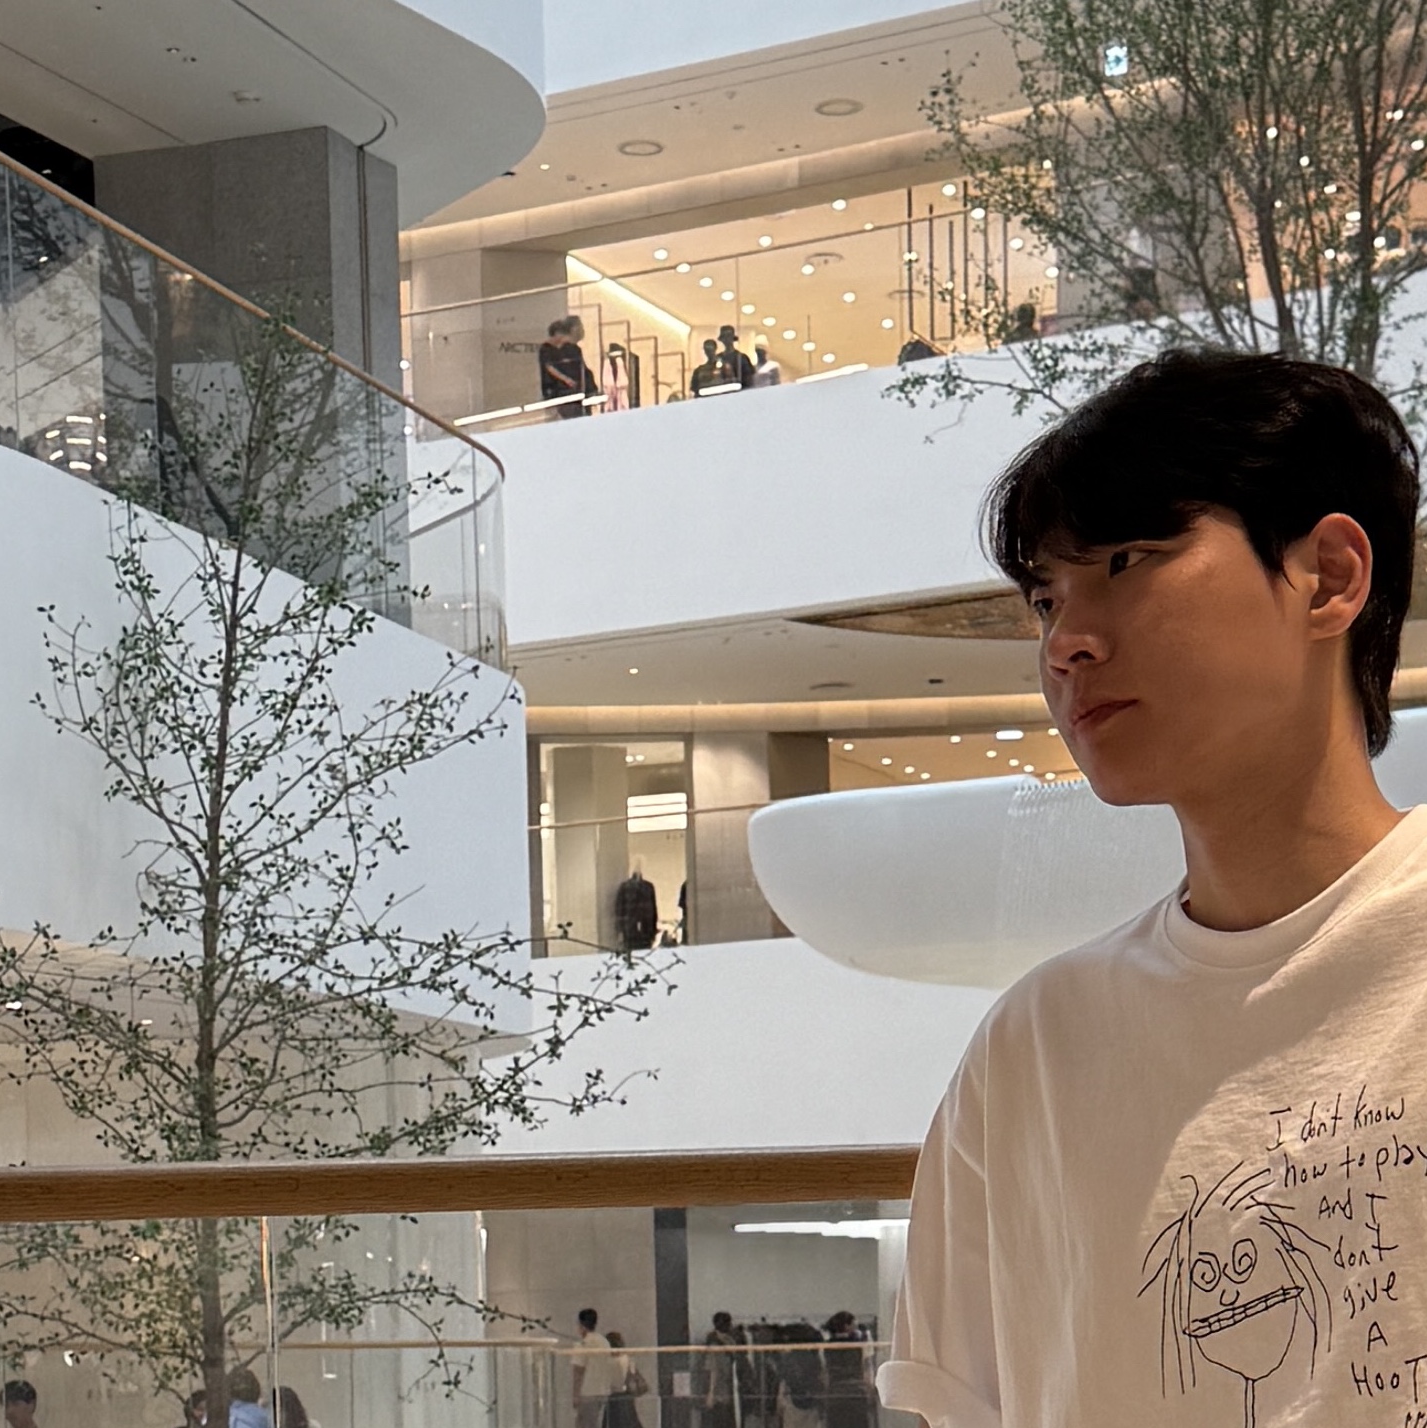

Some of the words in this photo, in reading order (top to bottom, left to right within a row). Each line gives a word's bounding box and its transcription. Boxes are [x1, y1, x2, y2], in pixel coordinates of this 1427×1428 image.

[1265, 1106, 1292, 1152] I
[1353, 1084, 1405, 1130] know
[1283, 1152, 1328, 1188] how
[1343, 1270, 1398, 1320] give
[1367, 1320, 1388, 1353] A
